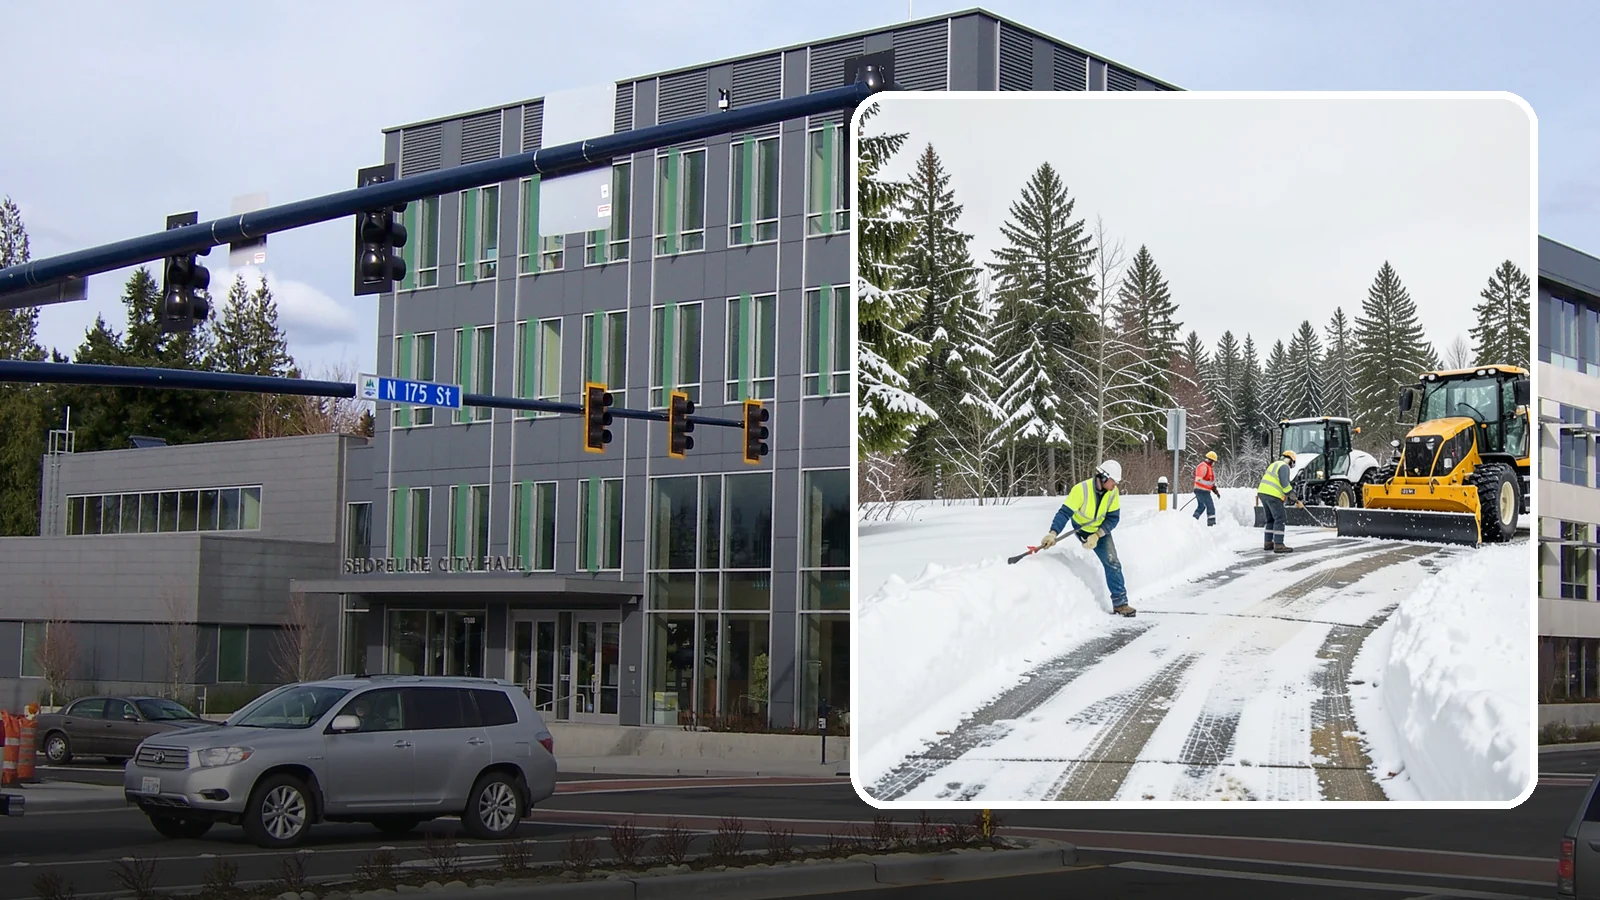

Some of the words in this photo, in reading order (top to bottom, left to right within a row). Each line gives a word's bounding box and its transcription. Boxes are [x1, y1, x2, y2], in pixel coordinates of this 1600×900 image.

[387, 380, 396, 400] N
[405, 382, 428, 403] 175
[436, 386, 451, 406] St
[343, 557, 432, 574] SHORELINE
[438, 556, 475, 573] CITY
[484, 555, 526, 571] HALL
